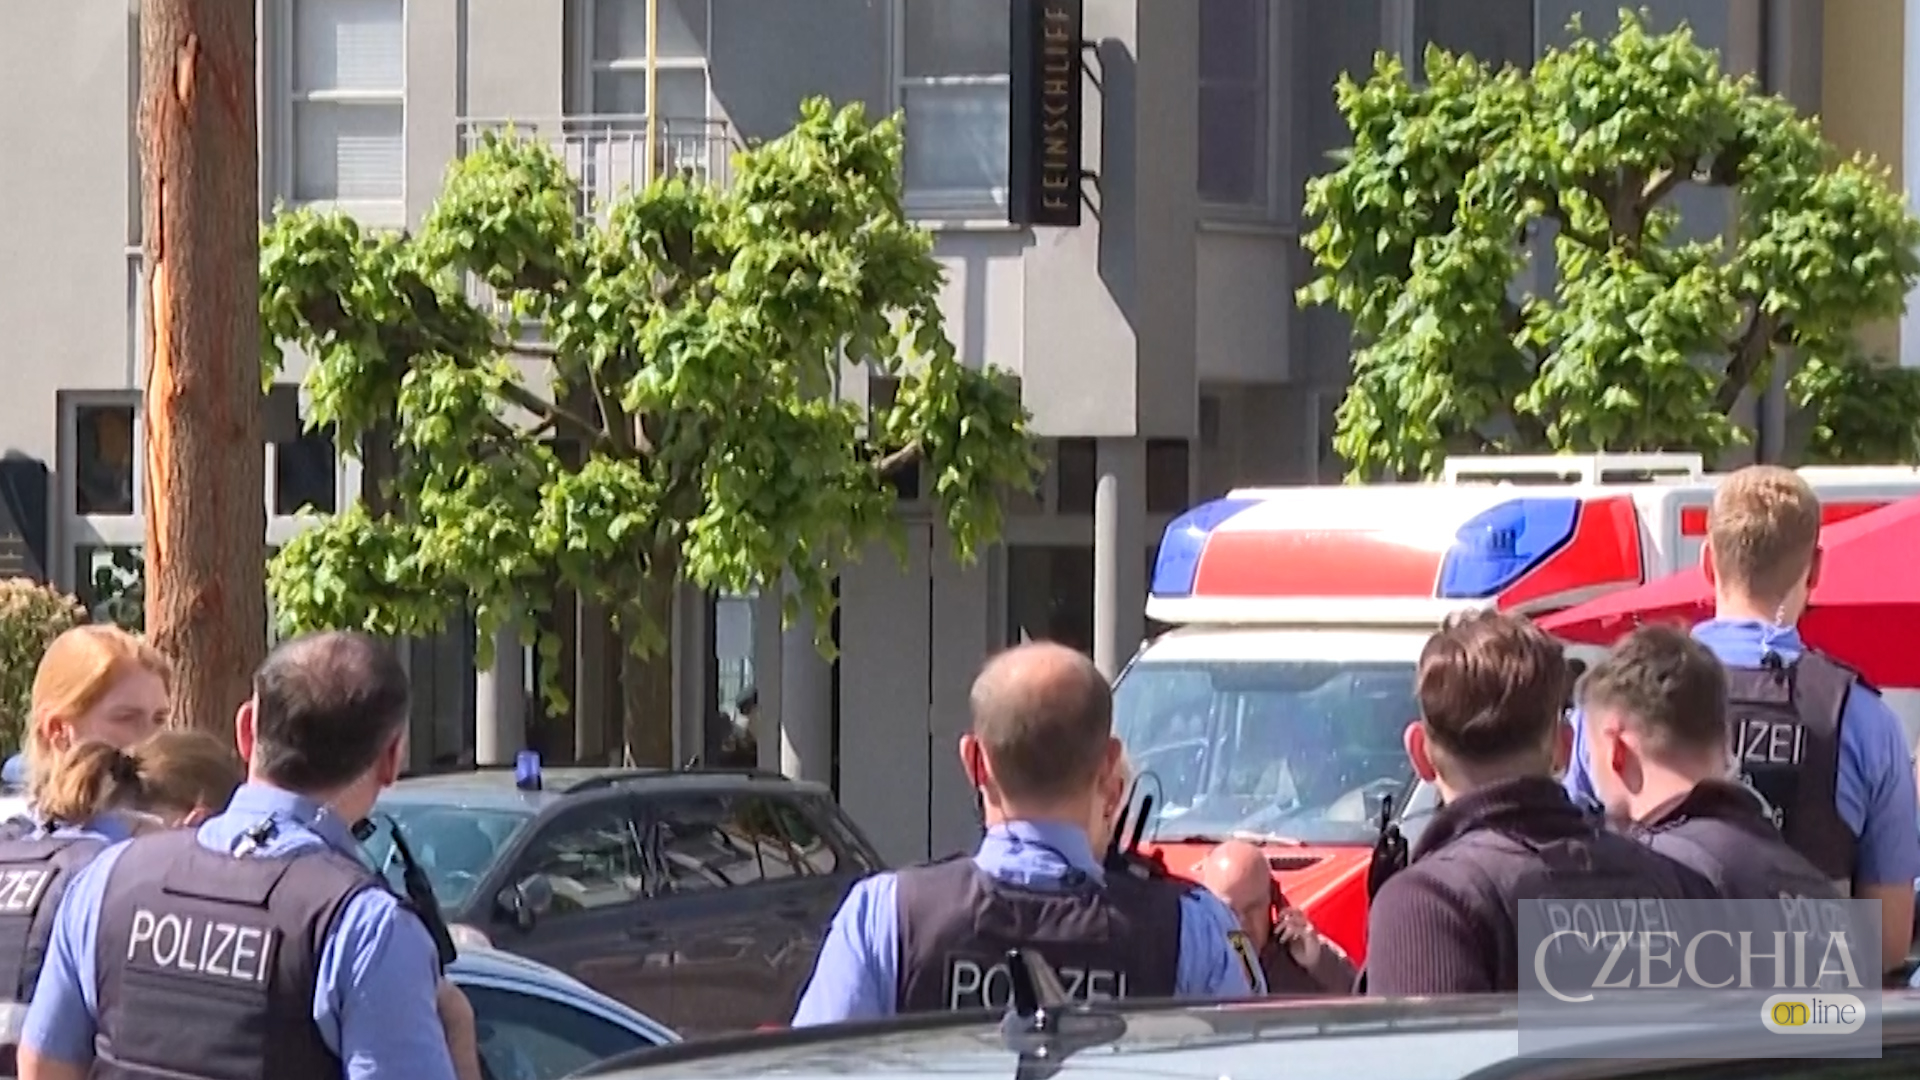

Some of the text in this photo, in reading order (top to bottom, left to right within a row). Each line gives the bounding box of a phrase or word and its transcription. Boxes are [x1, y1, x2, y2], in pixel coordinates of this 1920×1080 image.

[1043, 7, 1070, 208] FEINSCHLIFF
[1736, 719, 1802, 765] IZEI
[127, 908, 272, 982] POLIZEI
[951, 960, 1127, 1012] POZEI
